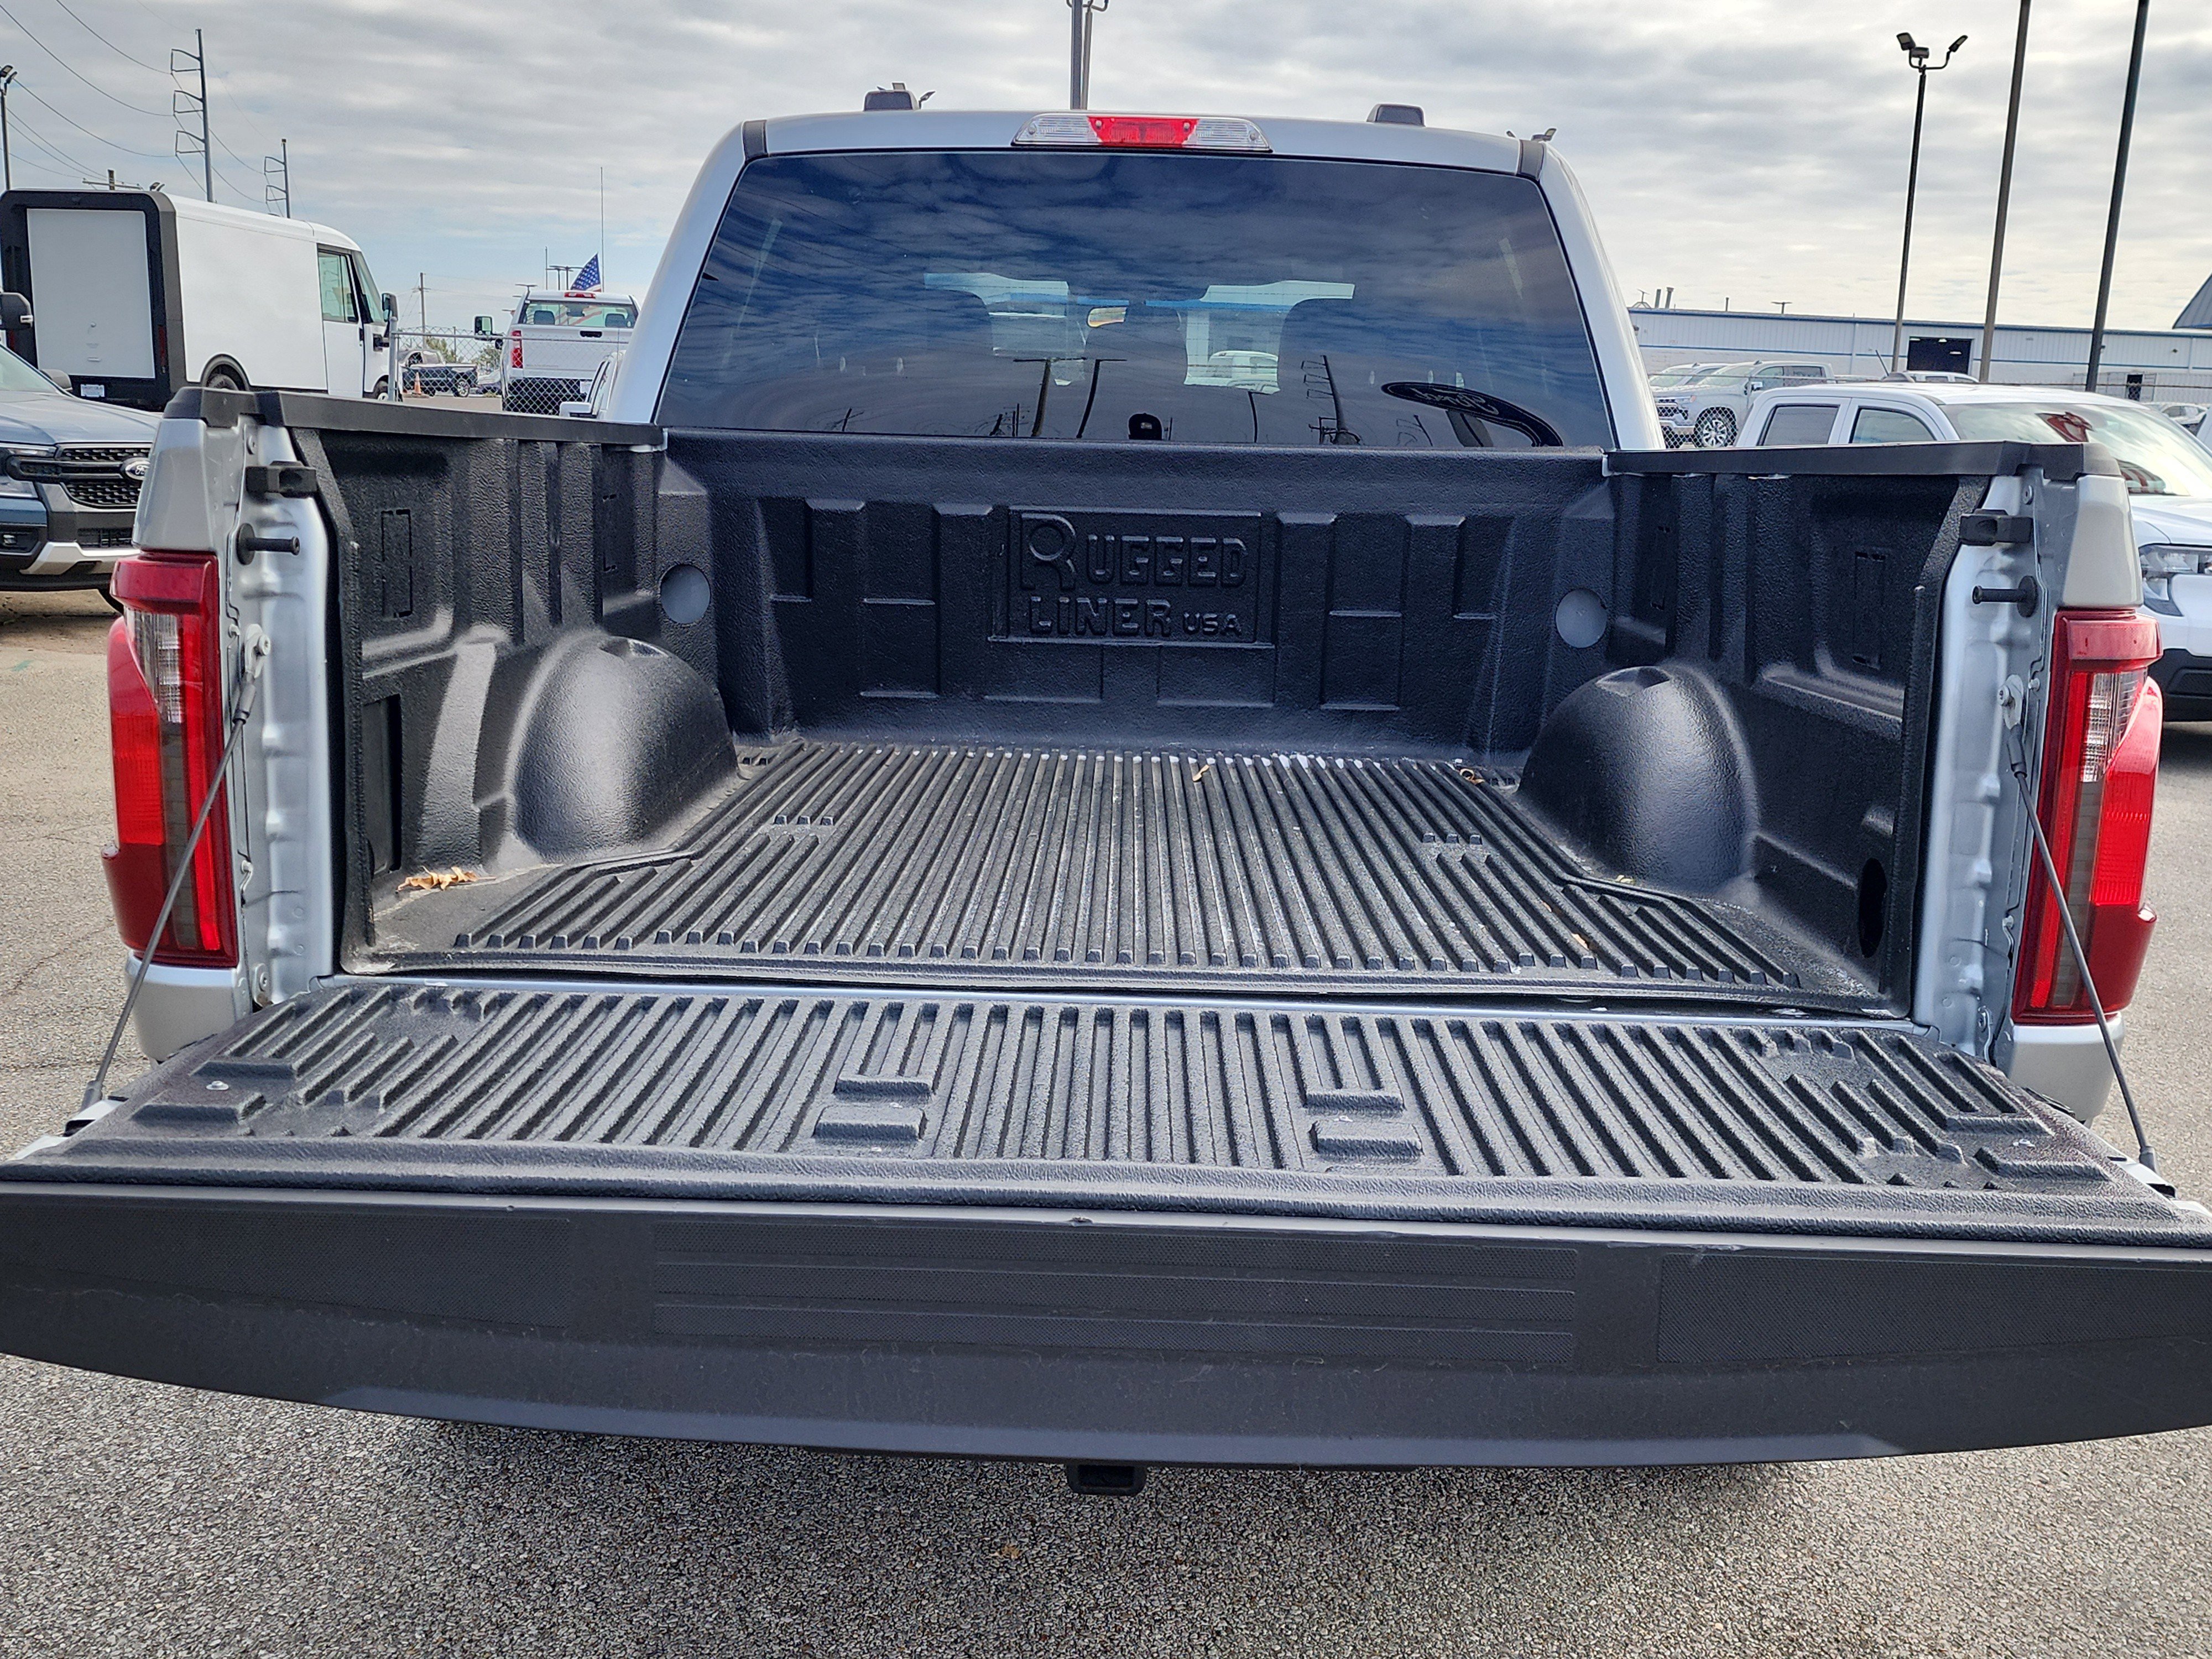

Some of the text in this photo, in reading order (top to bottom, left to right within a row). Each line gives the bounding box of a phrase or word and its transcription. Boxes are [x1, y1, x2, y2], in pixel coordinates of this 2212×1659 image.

[1020, 512, 1248, 591] RUGGED
[1030, 596, 1242, 637] LINER USA
